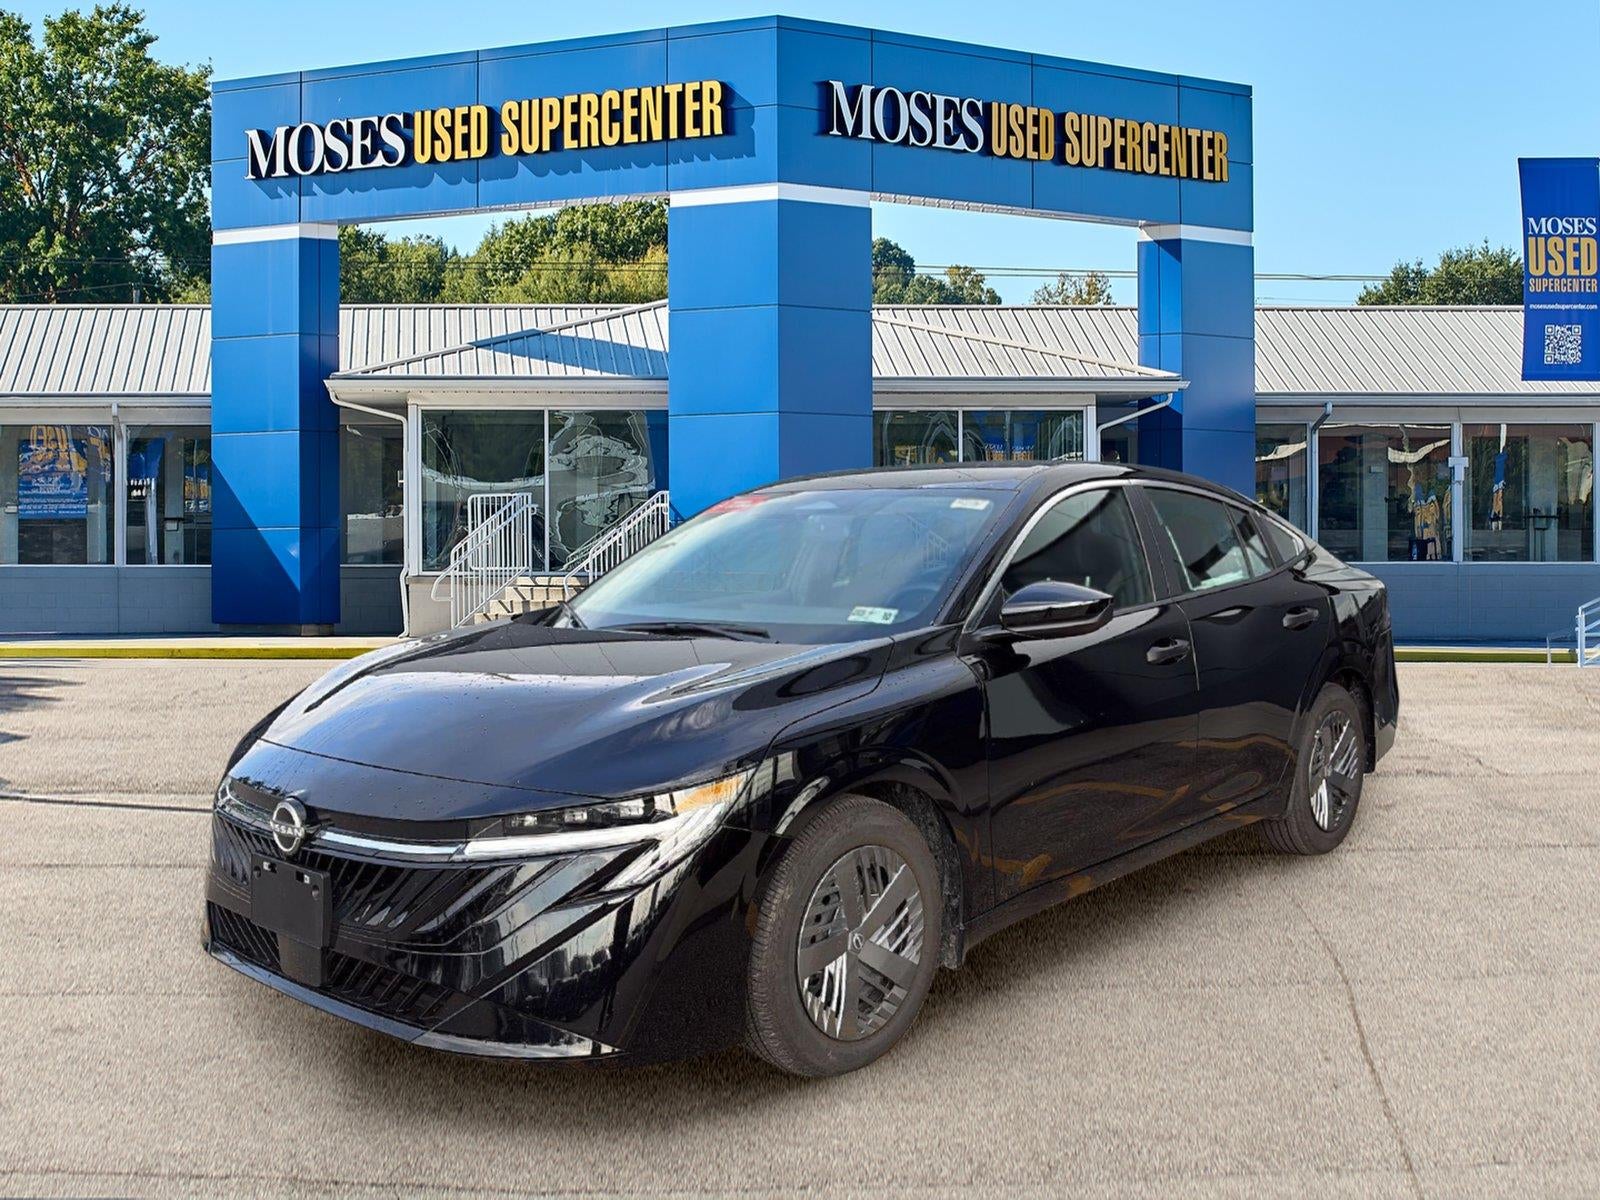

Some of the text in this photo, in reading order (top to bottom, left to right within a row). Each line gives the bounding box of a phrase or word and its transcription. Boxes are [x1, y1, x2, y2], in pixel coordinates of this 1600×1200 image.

[245, 79, 724, 181] MOSES USED SUPERCENTER
[828, 79, 1230, 183] MOSES USED SUPERCENTER
[1527, 216, 1597, 236] MOSES
[1528, 236, 1598, 277] USED
[1529, 277, 1598, 293] SUPERCENTER
